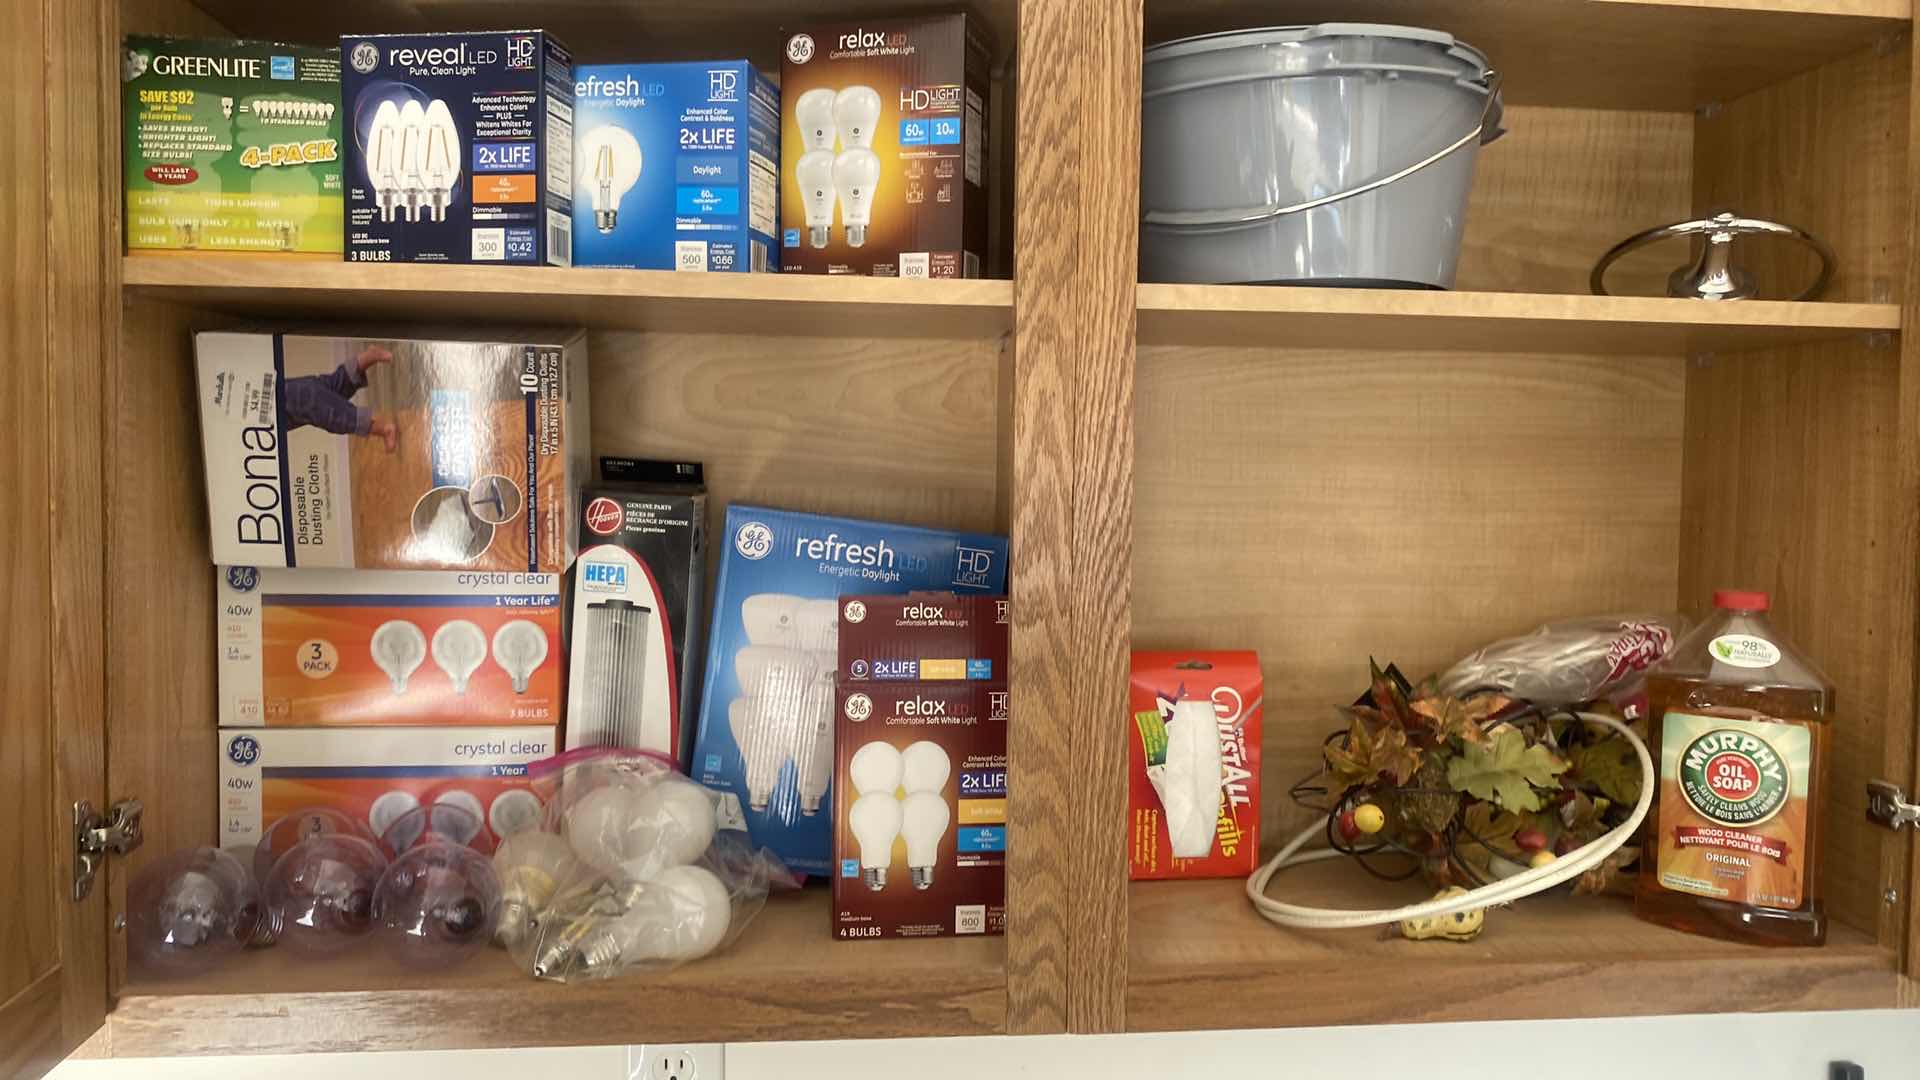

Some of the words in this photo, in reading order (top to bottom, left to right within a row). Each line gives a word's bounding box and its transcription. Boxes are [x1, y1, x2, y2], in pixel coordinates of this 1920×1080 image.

[840, 29, 884, 49] relax
[887, 34, 906, 45] LED
[391, 43, 465, 66] reveal
[469, 51, 497, 64] LED
[508, 40, 533, 57] HD
[830, 49, 865, 59] Comfortable
[867, 48, 879, 56] Soft
[880, 47, 898, 56] White
[900, 46, 915, 55] Light
[153, 55, 261, 78] GREENLITE
[508, 58, 532, 67] LIGHT
[410, 67, 429, 76] Pure,
[431, 67, 453, 75] Clean
[456, 67, 476, 75] Light
[575, 74, 639, 96] efresh
[643, 85, 664, 96] LED
[711, 74, 736, 90] HD
[140, 90, 169, 104] SAVE
[170, 91, 194, 105] $92
[503, 95, 536, 104] Technology
[711, 90, 735, 99] LIGHT
[900, 90, 929, 111] HD
[930, 88, 960, 100] LIGHT
[510, 103, 528, 111] Colors
[616, 99, 644, 108] Daylight
[477, 129, 510, 137] Exceptional
[512, 128, 532, 136] Clarity
[680, 129, 698, 144] 2x
[702, 129, 735, 143] LIFE
[240, 140, 337, 169] 4-PACK
[480, 148, 496, 163] 2x
[501, 147, 530, 162] LIFE
[693, 166, 721, 175] Daylight
[479, 242, 497, 251] 300
[508, 243, 532, 252] $0.42
[352, 252, 357, 261] 3
[360, 251, 390, 261] BULBS
[682, 255, 700, 264] 500
[540, 353, 548, 376] Cloths
[520, 374, 538, 394] 10
[540, 378, 548, 405] Dusting
[540, 407, 549, 442] Disposable
[541, 444, 550, 455] Dry
[309, 454, 320, 495] Cloths
[238, 424, 282, 545] Bona
[295, 475, 309, 545] Disposable
[311, 499, 323, 546] Dusting
[796, 534, 894, 568] refresh
[898, 554, 927, 570] LED
[958, 551, 990, 572] HD
[457, 573, 509, 587] crystal
[514, 573, 551, 585] clear
[586, 565, 625, 582] HEPA
[819, 563, 860, 577] Energetic
[861, 568, 900, 582] Daylight
[957, 571, 987, 585] LIGHT
[495, 597, 501, 606] 1
[503, 596, 528, 606] Year
[227, 605, 252, 616] 40w
[903, 602, 943, 619] relax
[311, 643, 322, 659] 3
[304, 662, 331, 671] PACK
[857, 665, 862, 673] 5
[875, 662, 888, 673] 2x
[892, 662, 916, 673] LIFE
[896, 695, 945, 715] relax
[518, 708, 548, 718] BULBS
[886, 716, 926, 726] Comfortable
[927, 715, 940, 725] Soft
[941, 716, 960, 725] White
[961, 716, 978, 726] Light
[454, 741, 507, 757] crystal
[511, 742, 547, 754] clear
[1686, 733, 1782, 782] MURPHY
[492, 766, 497, 775] 1
[500, 766, 524, 775] Year
[1719, 764, 1745, 778] OIL
[227, 779, 253, 789] 40w
[962, 774, 980, 788] 2x
[1713, 776, 1752, 791] SOAP
[1697, 785, 1720, 805] SAFELY
[1720, 803, 1749, 811] CLEANS
[1706, 805, 1713, 813] LE
[1716, 808, 1732, 819] BOIS
[1734, 811, 1753, 820] SANS
[311, 817, 322, 832] 3
[1698, 828, 1723, 836] WOOD
[1725, 831, 1762, 843] CLEANER
[1680, 836, 1724, 846] NETTOYANT
[1726, 839, 1749, 849] POUR
[1751, 844, 1761, 852] LE
[1761, 847, 1781, 857] BOIS
[1706, 852, 1751, 866] ORIGINAL
[840, 928, 847, 936] 4
[849, 927, 881, 936] BULBS
